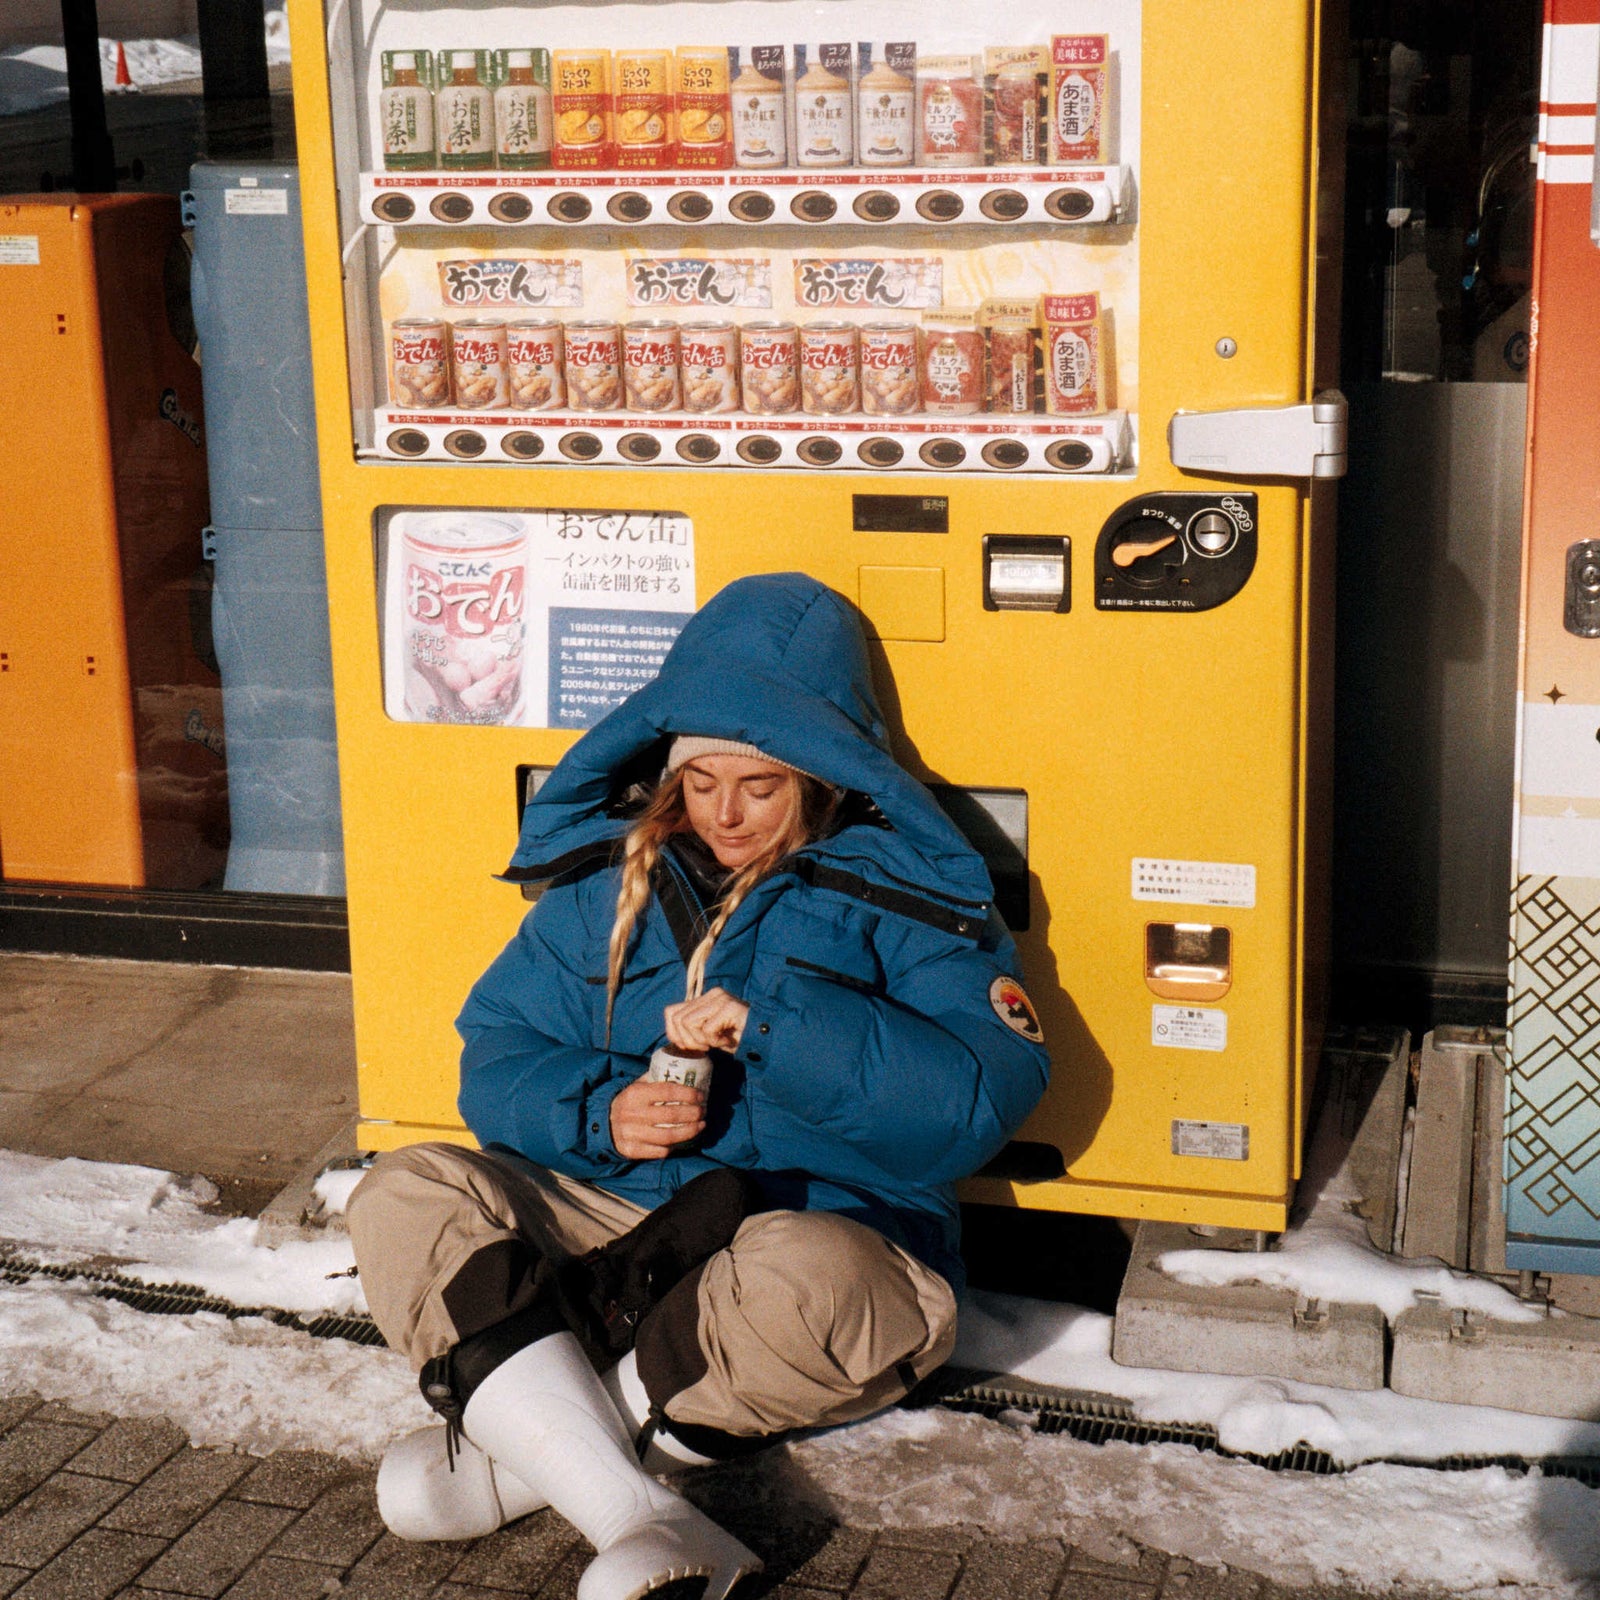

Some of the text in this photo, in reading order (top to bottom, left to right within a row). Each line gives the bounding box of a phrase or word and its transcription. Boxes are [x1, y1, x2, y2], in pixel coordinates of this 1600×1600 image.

[760, 48, 781, 58] コク
[828, 46, 849, 56] コク
[894, 45, 914, 55] コク
[1056, 48, 1100, 61] 美味しさ
[562, 68, 591, 79] じっくり
[622, 68, 651, 79] じっくり
[683, 67, 713, 78] じっくり
[562, 79, 592, 90] コトコト
[622, 79, 652, 90] コトコト
[683, 78, 714, 89] コトコト
[1061, 83, 1080, 137] あま酒
[386, 98, 407, 147] お茶
[448, 98, 472, 147] お茶
[504, 98, 529, 147] お茶
[446, 264, 548, 304] おでん
[633, 264, 737, 304] おでん
[801, 264, 906, 305] おでん
[1048, 307, 1092, 319] 美味しさ
[1057, 340, 1076, 390] あま酒
[439, 561, 494, 578] こてんぐ
[562, 572, 681, 594] 缶詰を開発する
[408, 566, 523, 636] おでん
